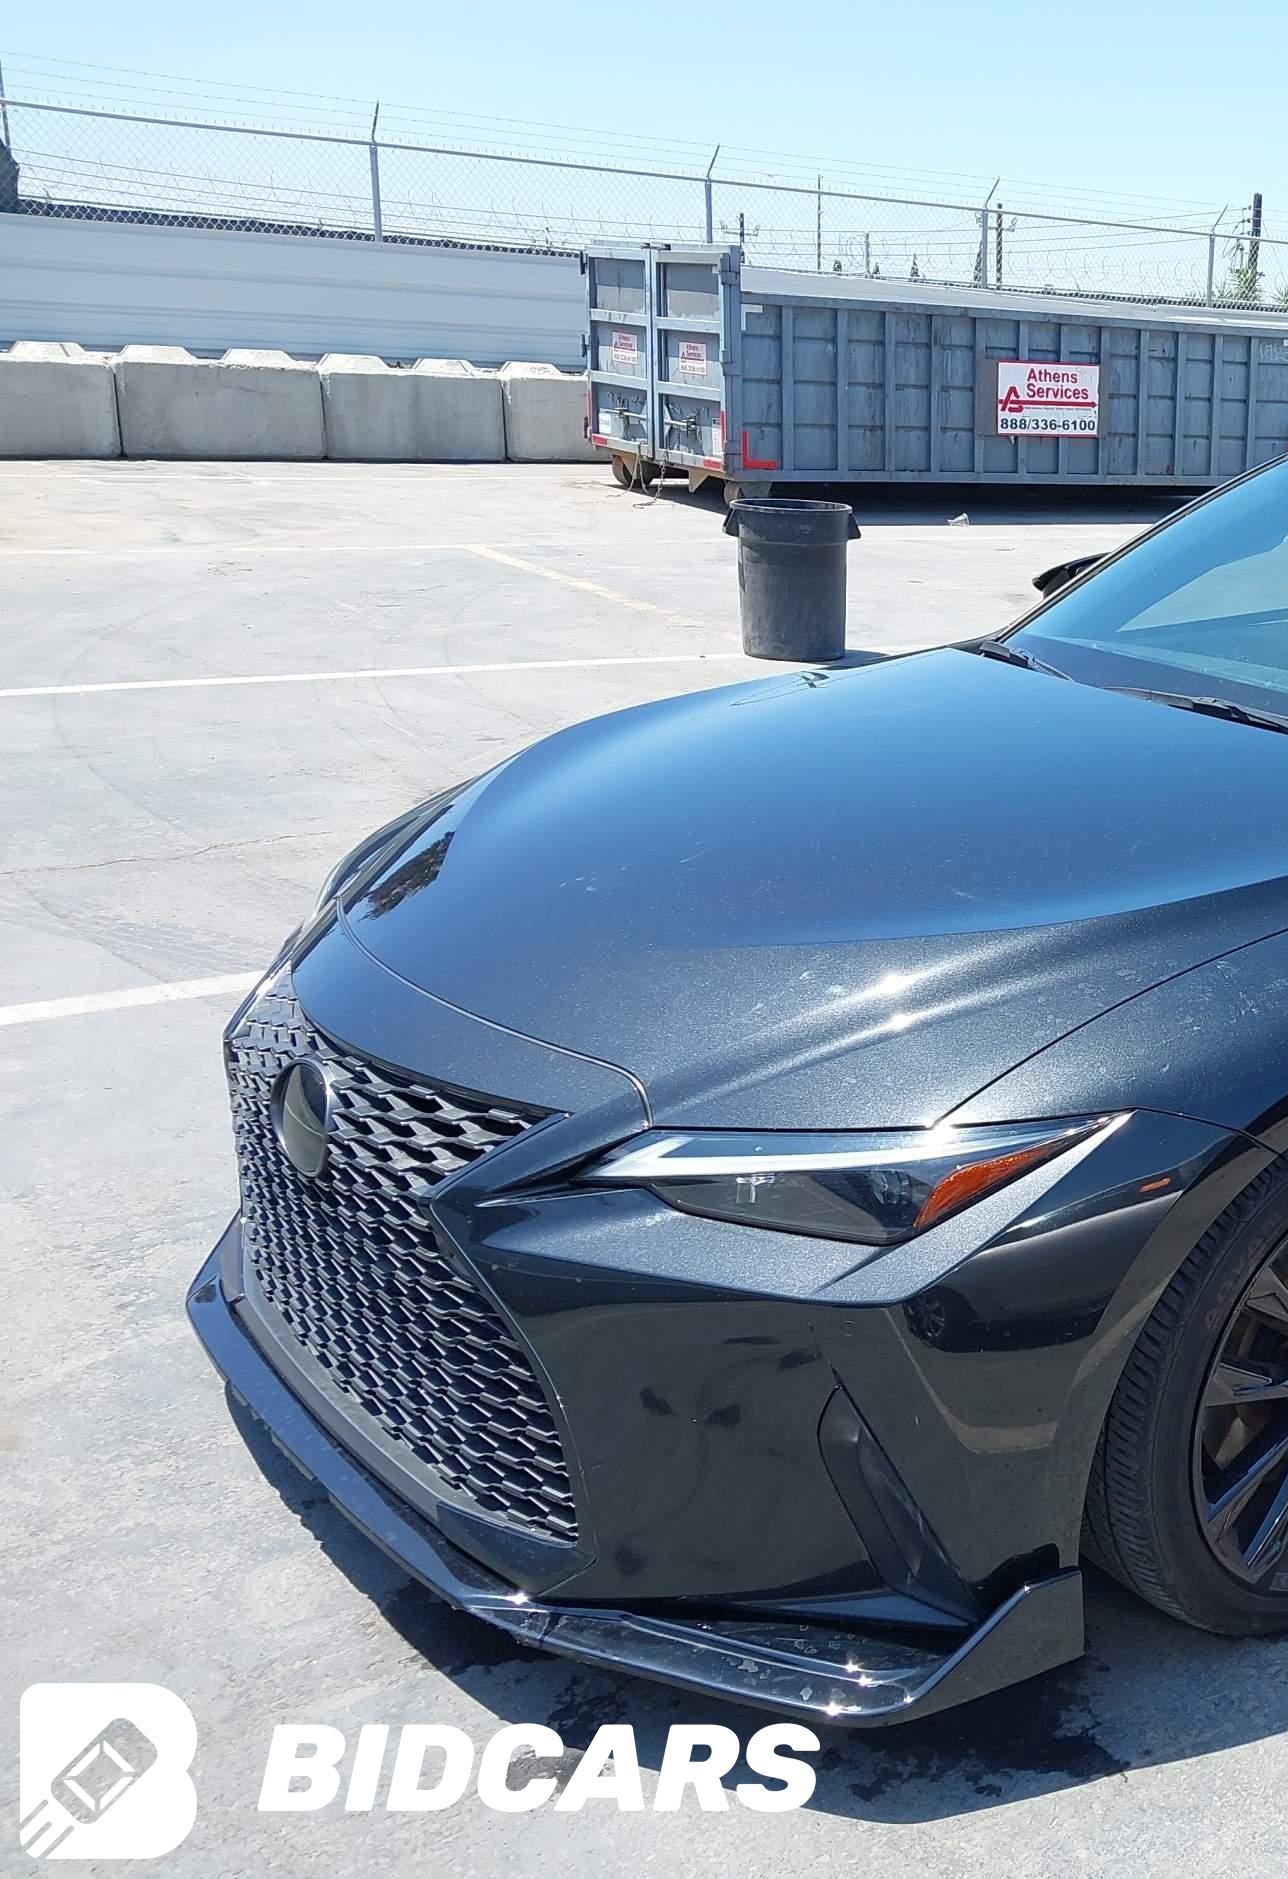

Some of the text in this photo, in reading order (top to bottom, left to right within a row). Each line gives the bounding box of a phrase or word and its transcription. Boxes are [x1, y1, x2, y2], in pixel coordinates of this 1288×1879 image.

[1027, 368, 1078, 384] Athens
[1026, 383, 1089, 400] Services
[1000, 418, 1095, 431] 888/336-6100
